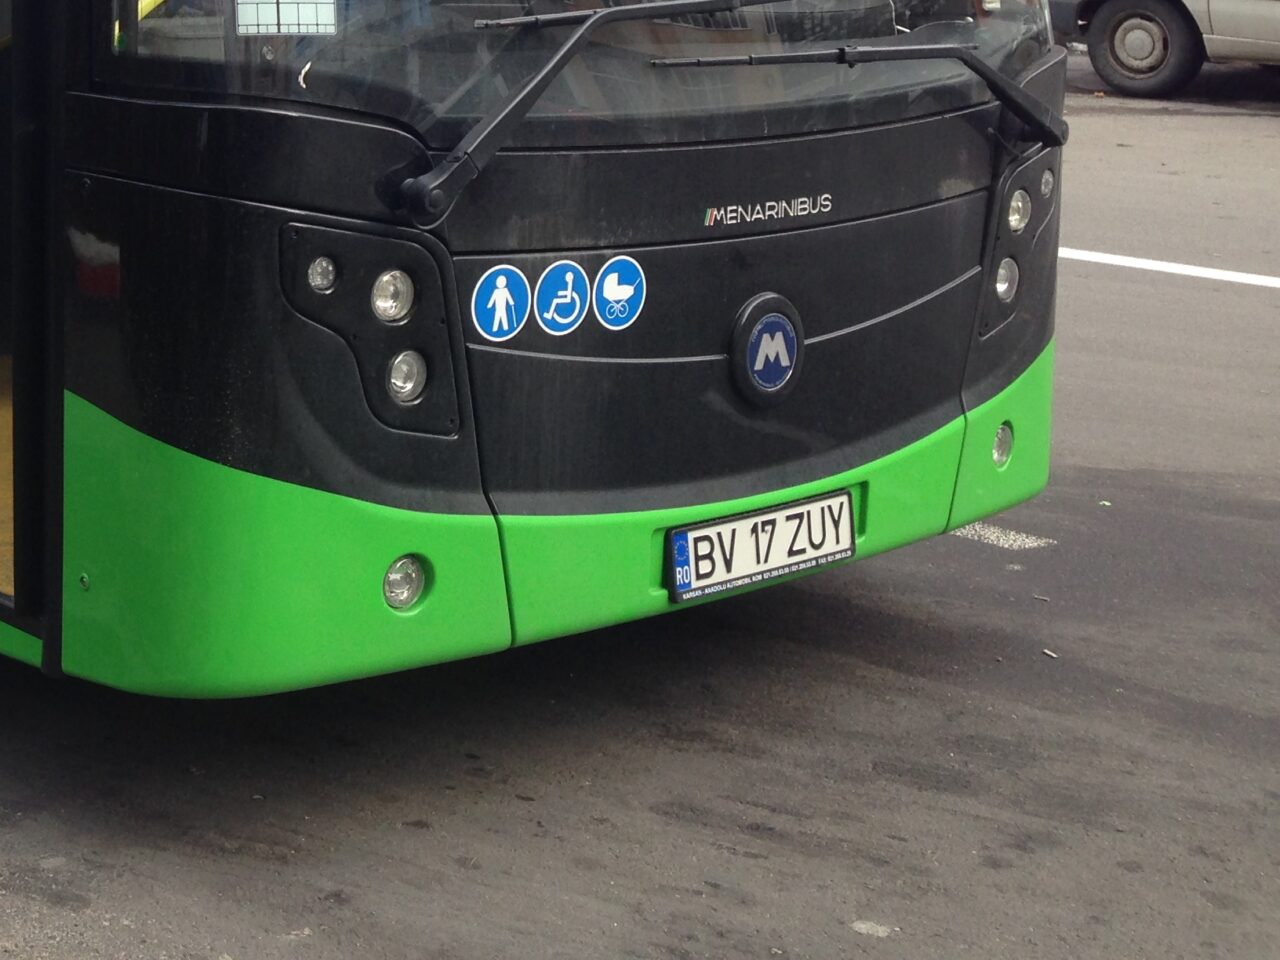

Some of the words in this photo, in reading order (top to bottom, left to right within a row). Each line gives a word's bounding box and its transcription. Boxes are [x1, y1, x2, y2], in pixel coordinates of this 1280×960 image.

[706, 193, 832, 226] MENARINIBUS
[693, 528, 737, 581] BV
[750, 518, 777, 565] 17
[785, 501, 844, 558] ZUY
[676, 565, 691, 586] RO
